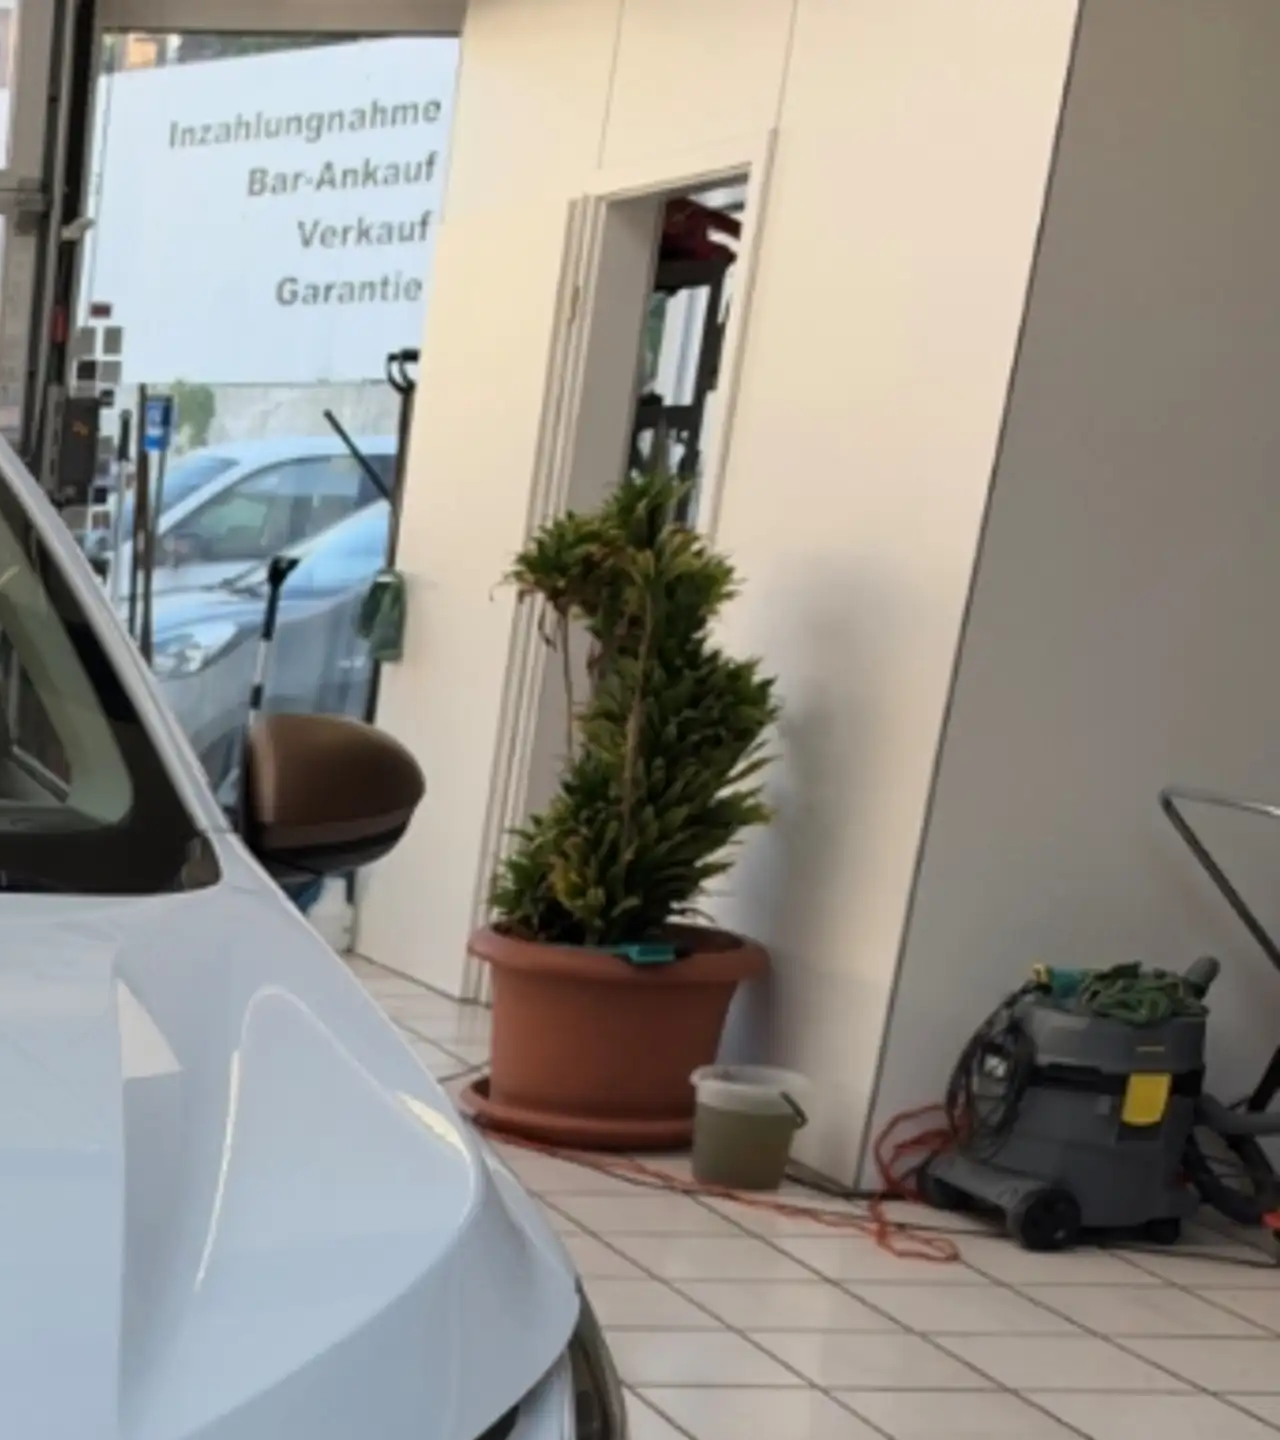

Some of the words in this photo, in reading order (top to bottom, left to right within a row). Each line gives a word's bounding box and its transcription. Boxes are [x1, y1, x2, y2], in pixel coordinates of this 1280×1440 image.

[168, 99, 442, 149] Inzahlungnahme
[247, 150, 437, 196] Bar-Ankauf
[297, 209, 432, 249] Verkauf
[275, 271, 424, 306] Garantie
